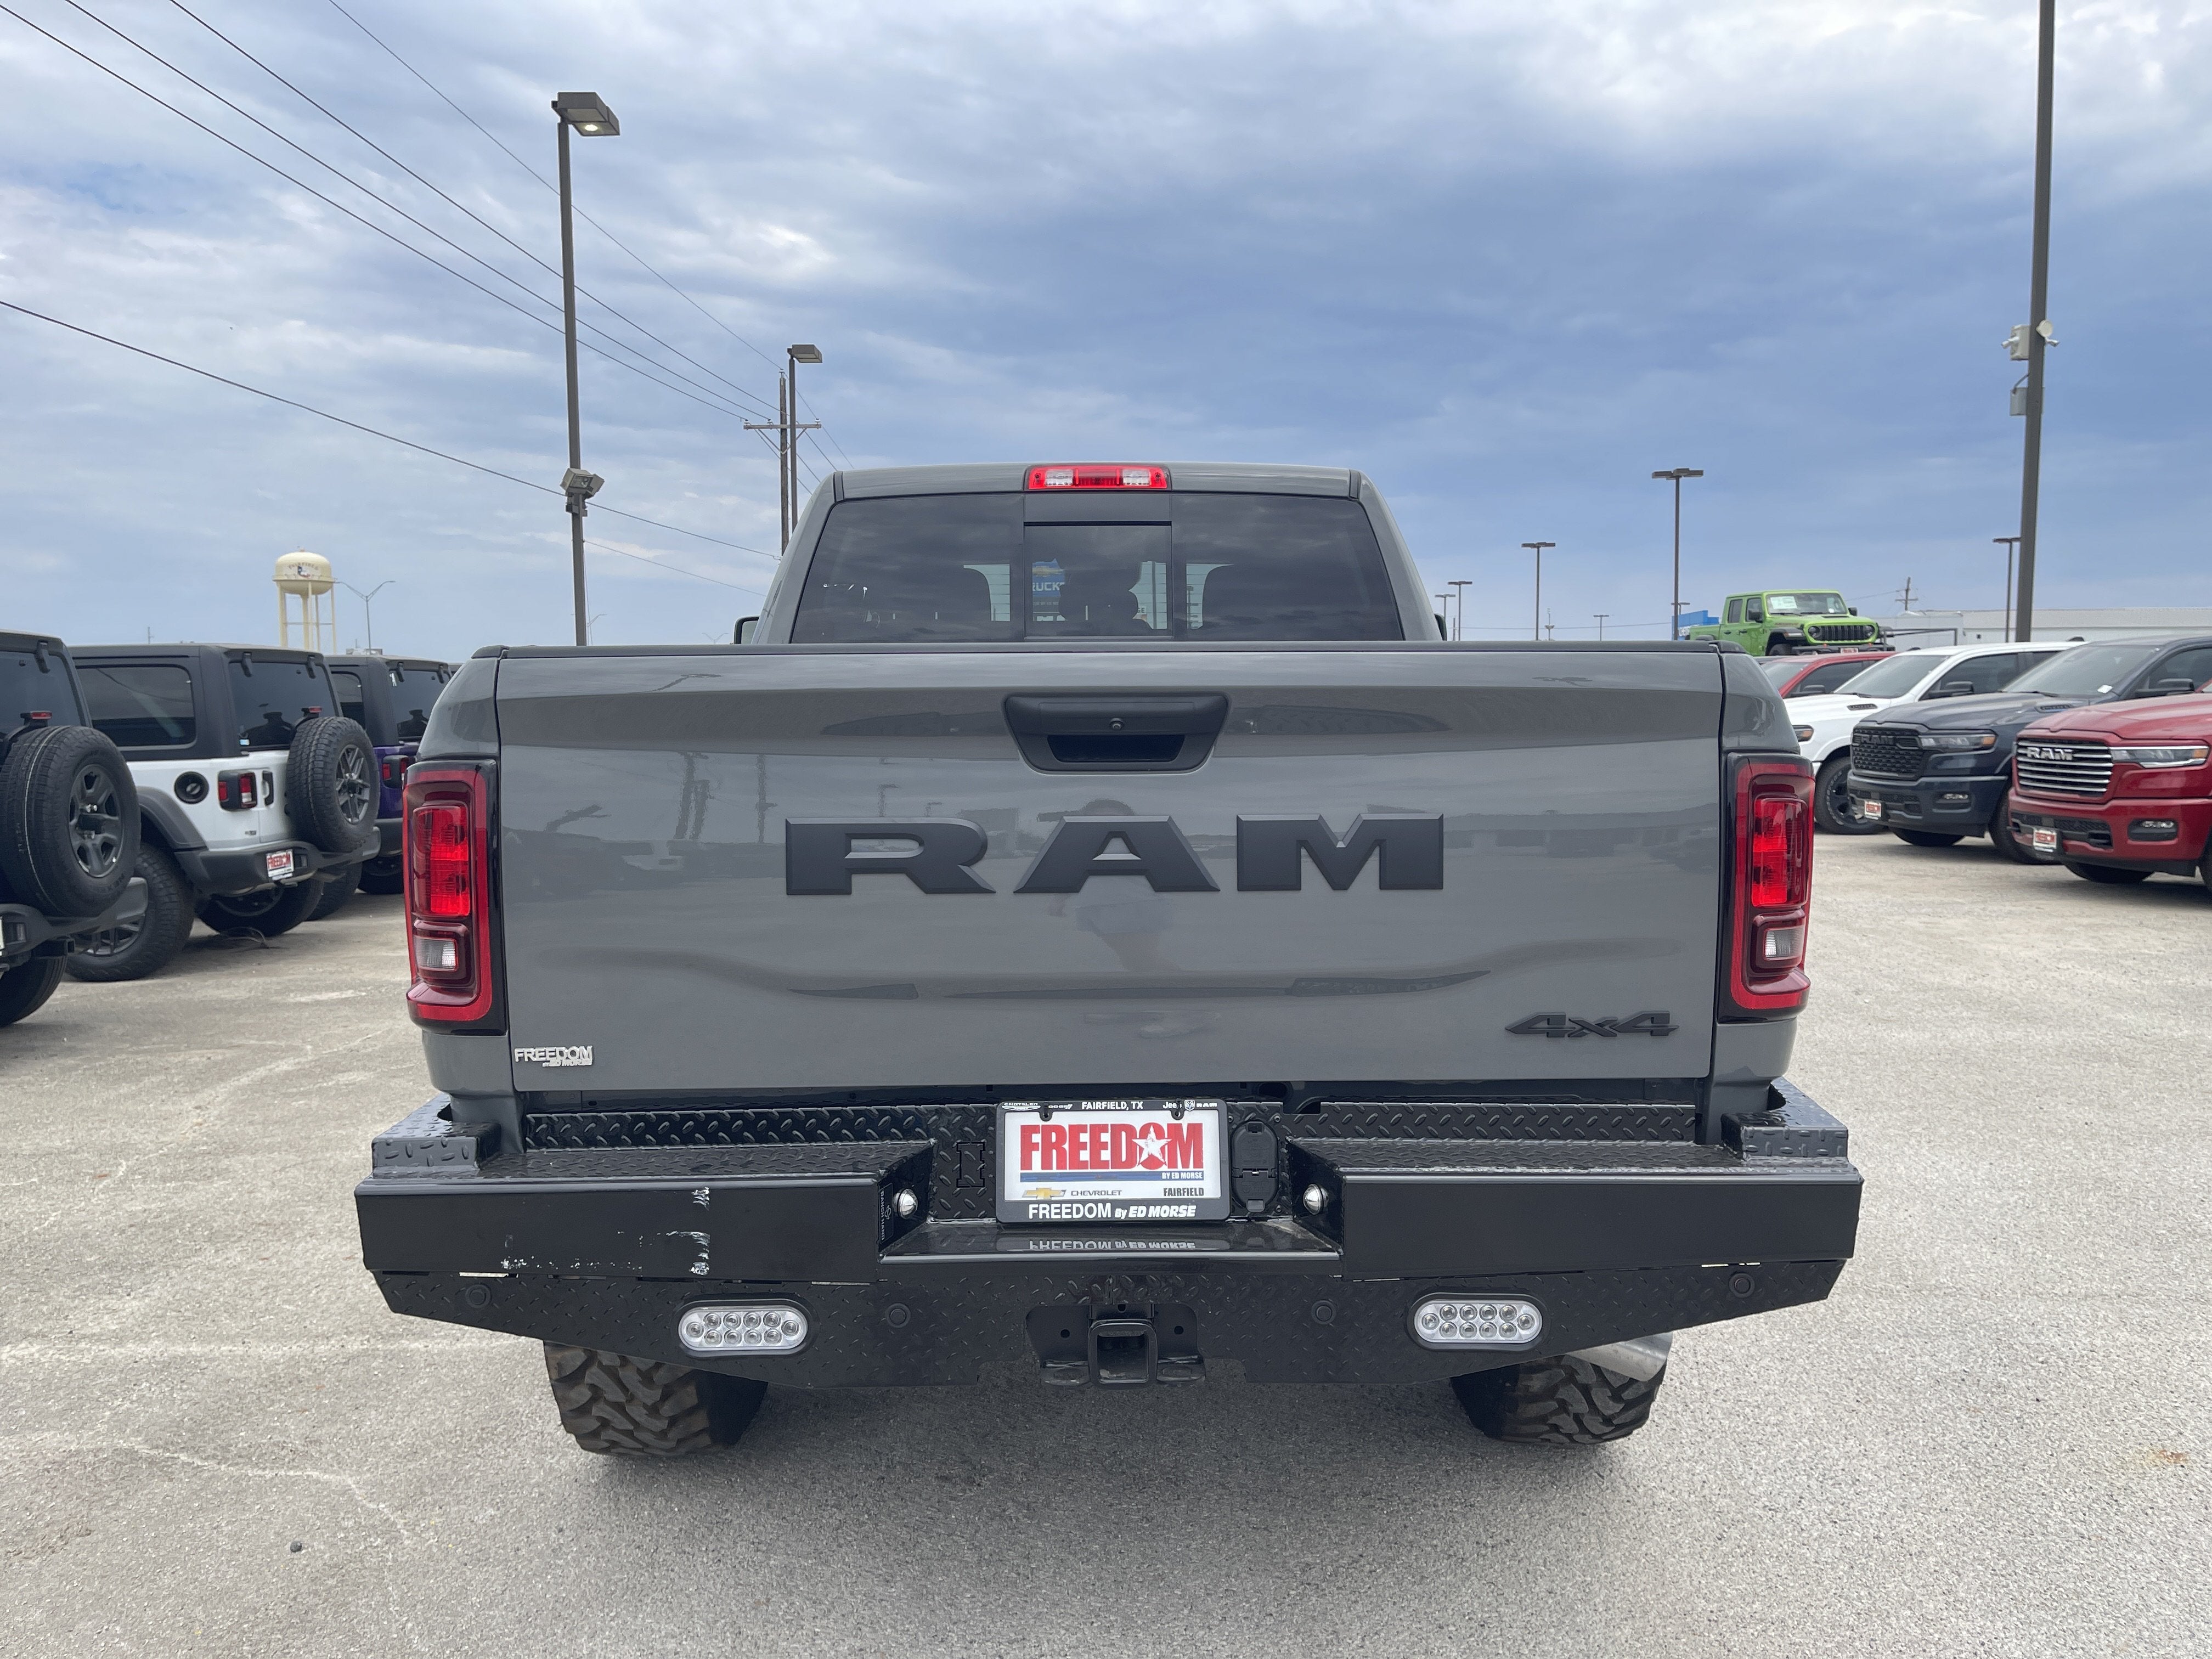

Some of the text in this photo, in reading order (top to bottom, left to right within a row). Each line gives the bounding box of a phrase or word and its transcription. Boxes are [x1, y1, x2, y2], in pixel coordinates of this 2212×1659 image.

[2027, 747, 2073, 760] RAM
[786, 812, 1444, 895] RAM
[514, 1046, 592, 1062] FREEDOM
[1082, 1102, 1128, 1110] FAIRFIELD,
[1020, 1122, 1204, 1170] FREEDOM
[1164, 1188, 1204, 1196] FAIRFIELD
[1029, 1203, 1197, 1220] FREEDOM By ED MORSE
